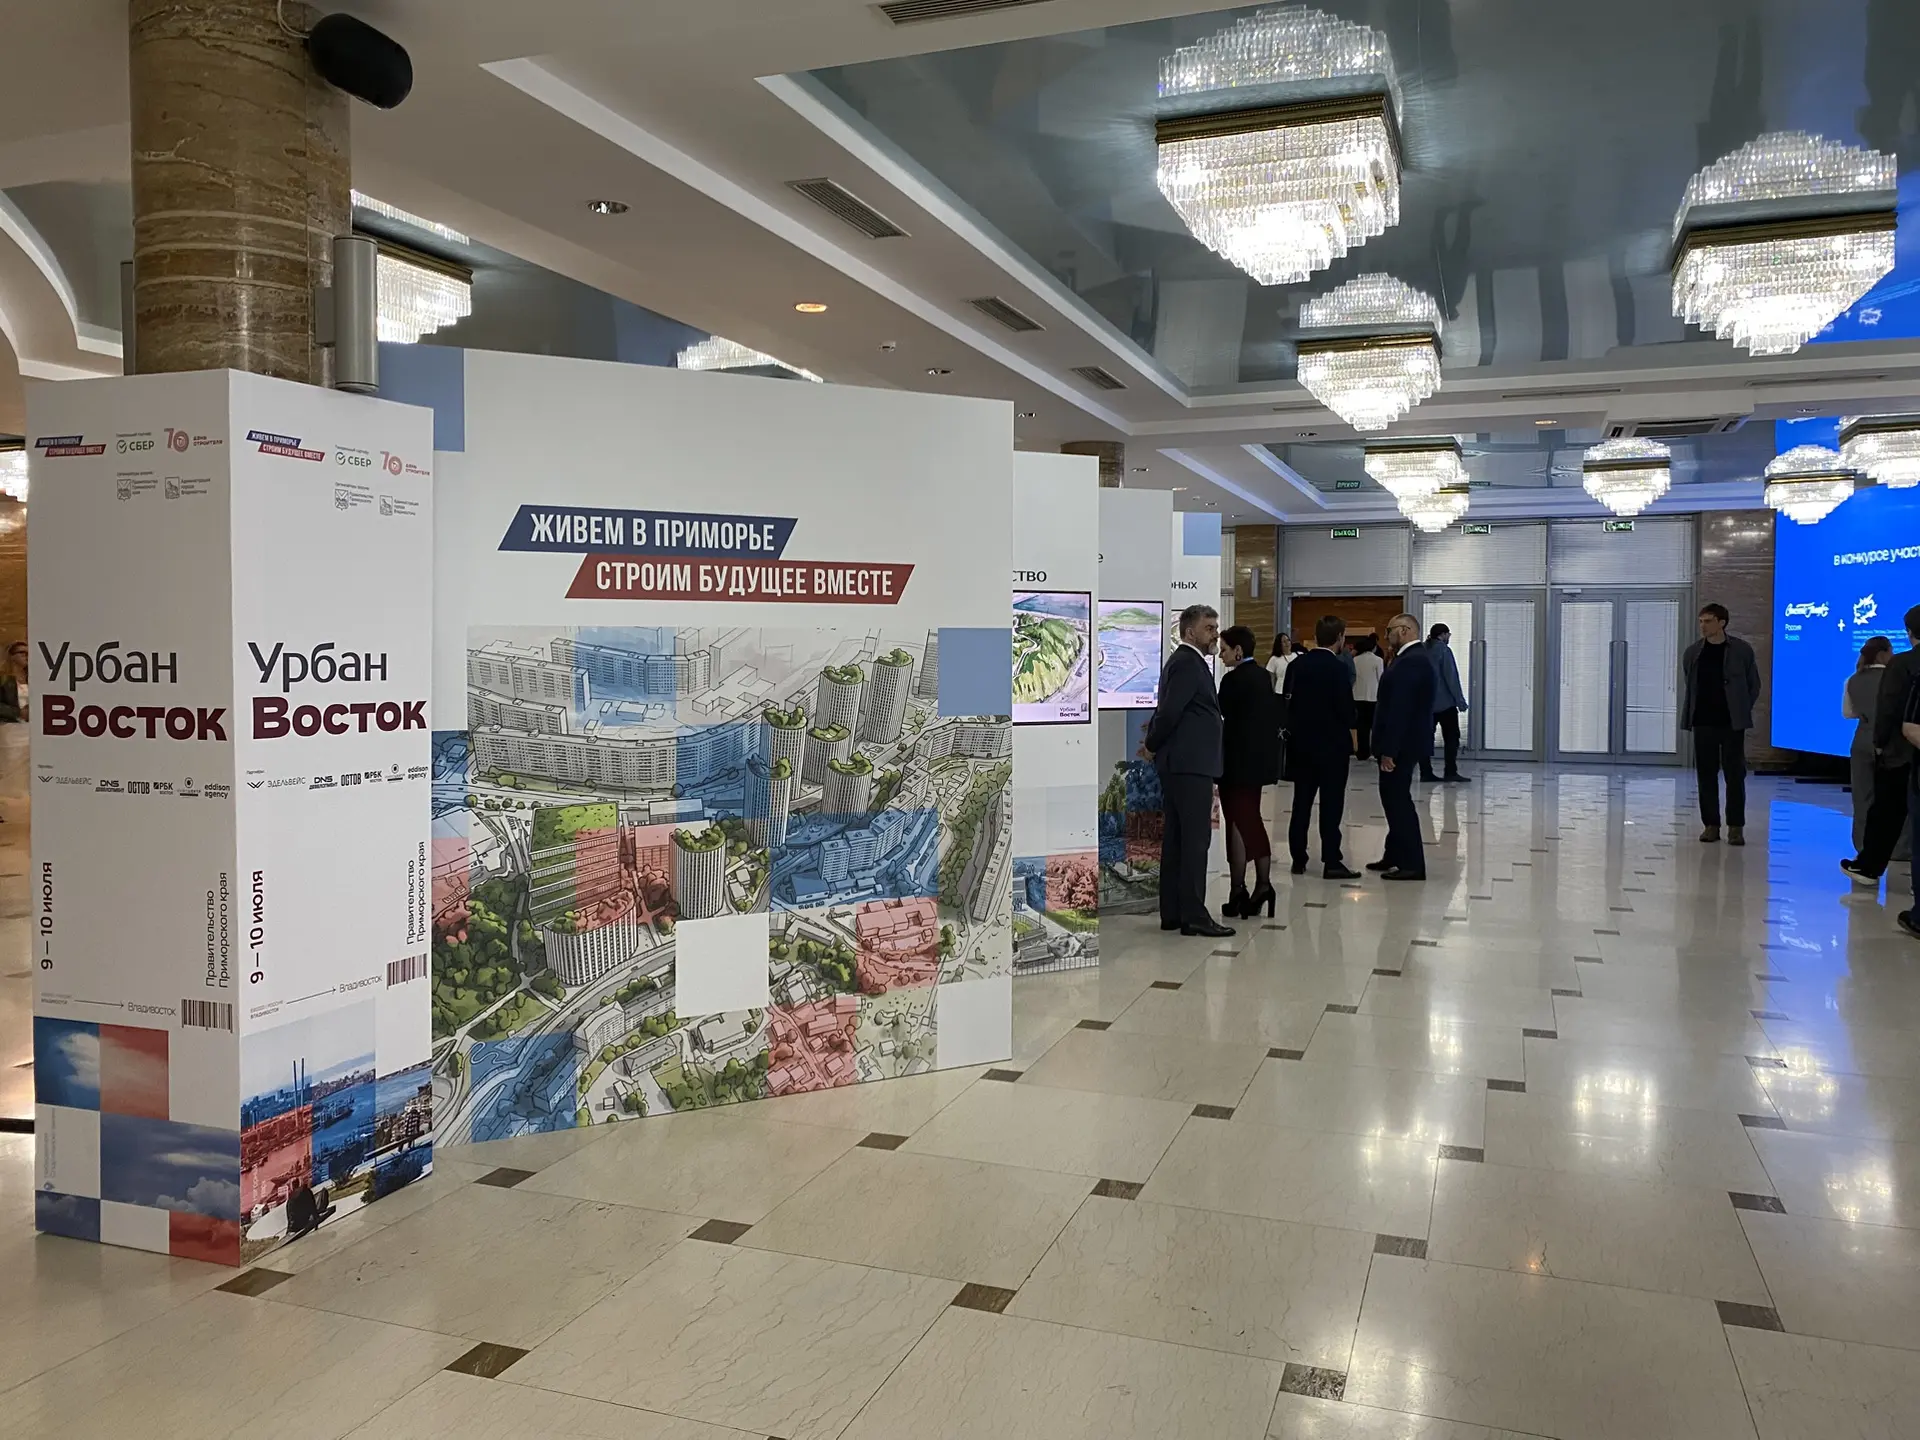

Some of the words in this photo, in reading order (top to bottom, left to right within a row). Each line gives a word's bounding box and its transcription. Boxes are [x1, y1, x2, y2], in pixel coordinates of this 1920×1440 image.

[129, 440, 155, 451] СБЕР
[347, 456, 372, 467] СБЕР
[531, 513, 624, 545] ЖИВЕМ
[633, 518, 647, 546] В
[655, 519, 775, 551] ПРИМОРЬЕ
[1841, 549, 1889, 566] конкурсе
[596, 561, 691, 592] СТРОИМ
[700, 564, 807, 596] БУДУЩЕЕ
[814, 568, 893, 596] ВМЕСТЕ
[38, 641, 177, 691] Урбан
[247, 642, 387, 692] Урбан
[42, 695, 228, 741] Восток
[252, 697, 427, 740] Восток
[369, 771, 382, 779] РБК
[407, 766, 429, 774] eddison
[407, 772, 427, 781] agency
[100, 780, 119, 788] DNS
[128, 781, 150, 794] ОСТОВ
[159, 782, 173, 791] РБК
[204, 783, 230, 791] eddison
[267, 777, 306, 788] ЭДЕЛЬВЕЙС
[314, 776, 333, 784] DNS
[341, 773, 362, 787] ОСТОВ
[204, 791, 228, 799] agency
[418, 841, 427, 867] края
[42, 862, 53, 913] июля
[219, 872, 230, 902] края
[252, 870, 263, 924] июля
[406, 860, 416, 945] Правительство
[417, 868, 427, 943] Приморского
[40, 917, 53, 937] 10
[205, 890, 217, 987] Правительство
[218, 903, 230, 988] Приморского
[250, 927, 264, 950] 10
[41, 959, 53, 970] 9
[250, 971, 264, 984] 9
[339, 975, 383, 993] Владивосток
[128, 1001, 177, 1017] Владивосток
